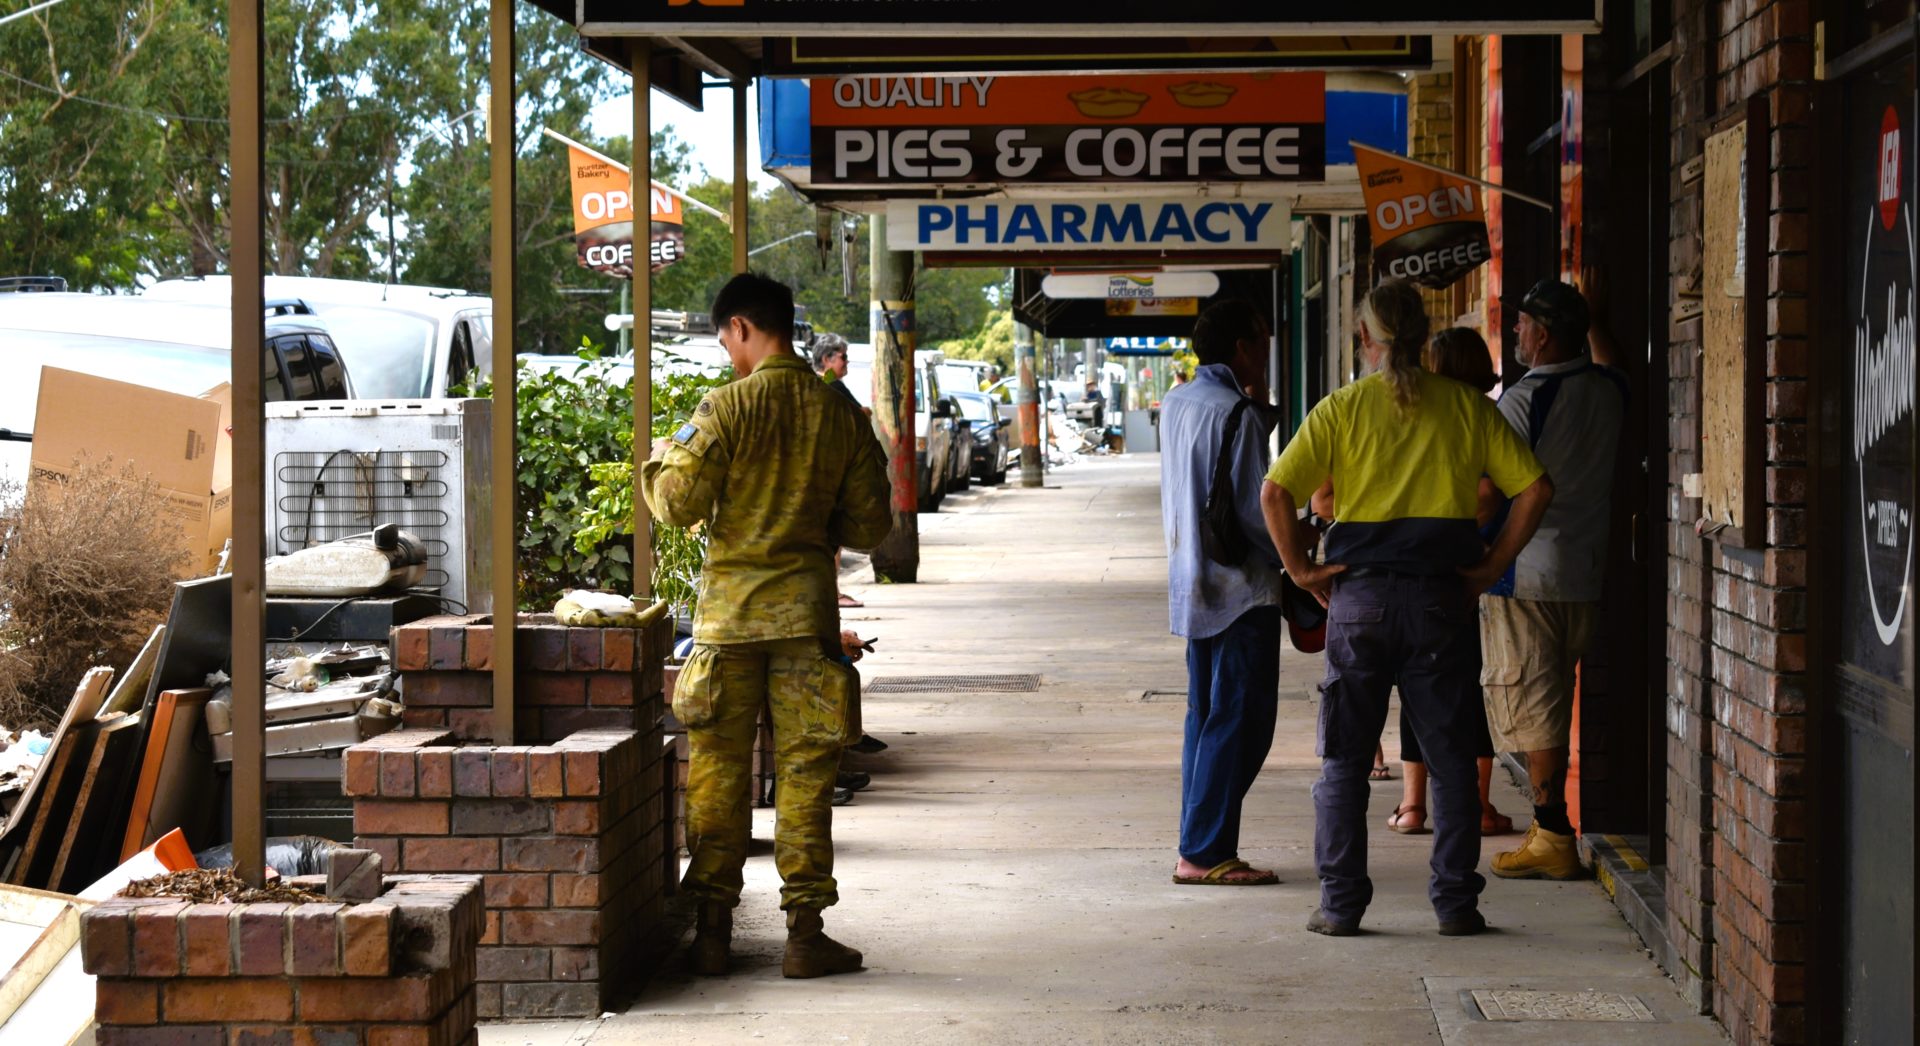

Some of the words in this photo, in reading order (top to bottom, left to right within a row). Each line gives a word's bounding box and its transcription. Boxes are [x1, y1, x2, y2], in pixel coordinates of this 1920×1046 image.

[834, 77, 995, 107] QUALITY
[835, 129, 973, 178] PIES
[995, 129, 1043, 178] &
[1064, 127, 1300, 176] COFFEE
[1879, 128, 1900, 202] IGA
[577, 170, 610, 178] Bakery
[1368, 174, 1403, 188] Bakery
[581, 189, 673, 220] OPN
[1376, 185, 1474, 230] OPEN
[917, 202, 1273, 244] PHARMACY
[586, 240, 675, 266] COFEE
[1389, 241, 1482, 279] COFFEE
[1108, 286, 1154, 297] Lotteries
[34, 467, 69, 484] EPSON
[1877, 499, 1898, 548] XPRESS
